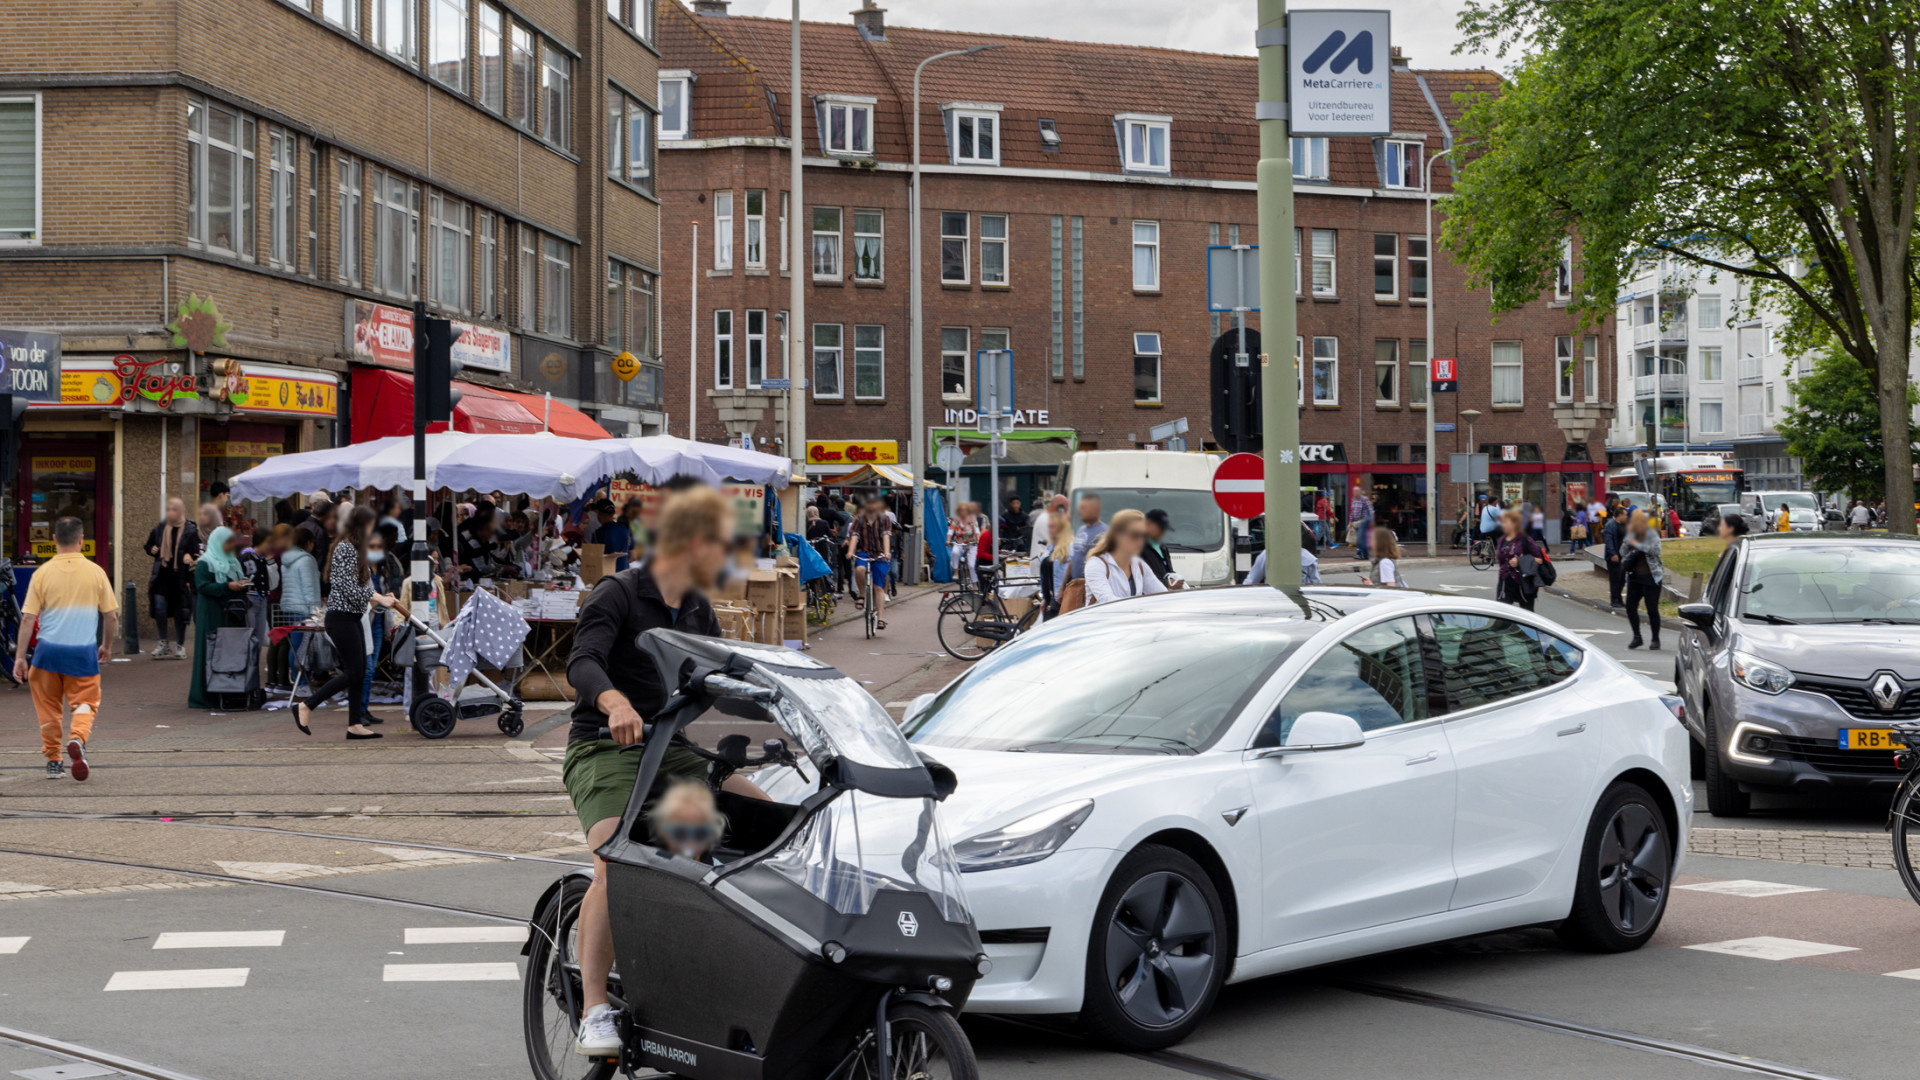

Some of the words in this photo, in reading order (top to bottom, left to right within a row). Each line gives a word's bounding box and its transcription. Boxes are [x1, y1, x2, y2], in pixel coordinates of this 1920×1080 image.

[1308, 101, 1374, 110] Uitzendbureau
[1308, 113, 1329, 121] Voor
[1332, 113, 1374, 121] Iedereen!
[10, 347, 28, 362] van
[30, 341, 47, 363] der
[10, 369, 48, 391] TOORN
[1013, 410, 1049, 424] ATE
[811, 445, 842, 461] Bon
[846, 445, 878, 461] Bini
[1298, 445, 1335, 461] KFC
[34, 460, 66, 469] INKOOP
[70, 460, 93, 469] GOUD
[37, 544, 57, 554] DIRE
[641, 1038, 667, 1058] URBAN
[668, 1047, 697, 1067] ARROW
